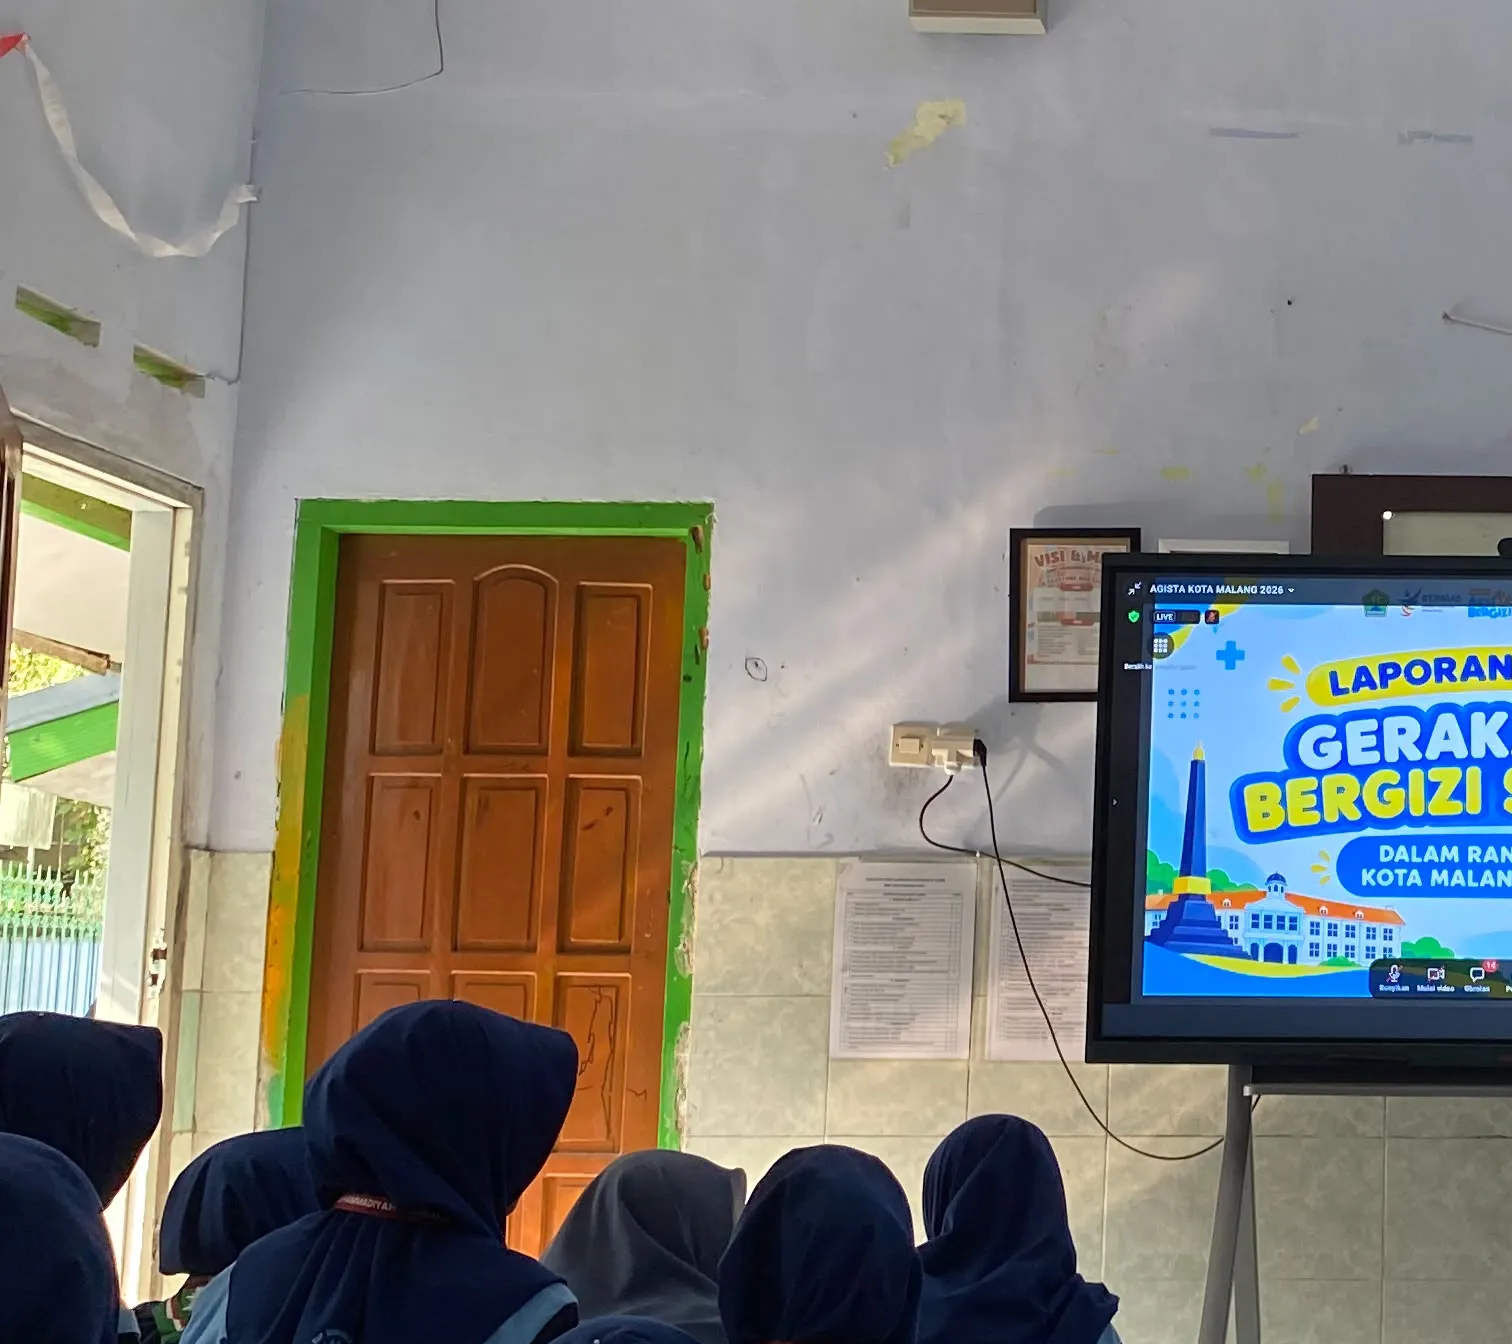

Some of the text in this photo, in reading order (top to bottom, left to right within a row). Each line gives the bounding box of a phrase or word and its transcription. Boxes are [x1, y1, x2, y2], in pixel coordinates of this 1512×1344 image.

[1034, 550, 1066, 567] VISI
[1150, 584, 1284, 595] AGISTA KOTA MALANG 2026
[1156, 613, 1174, 621] LIVE
[1242, 766, 1483, 834] BERGIZI
[1379, 844, 1459, 865] DALAM
[1361, 868, 1423, 888] KOTA
